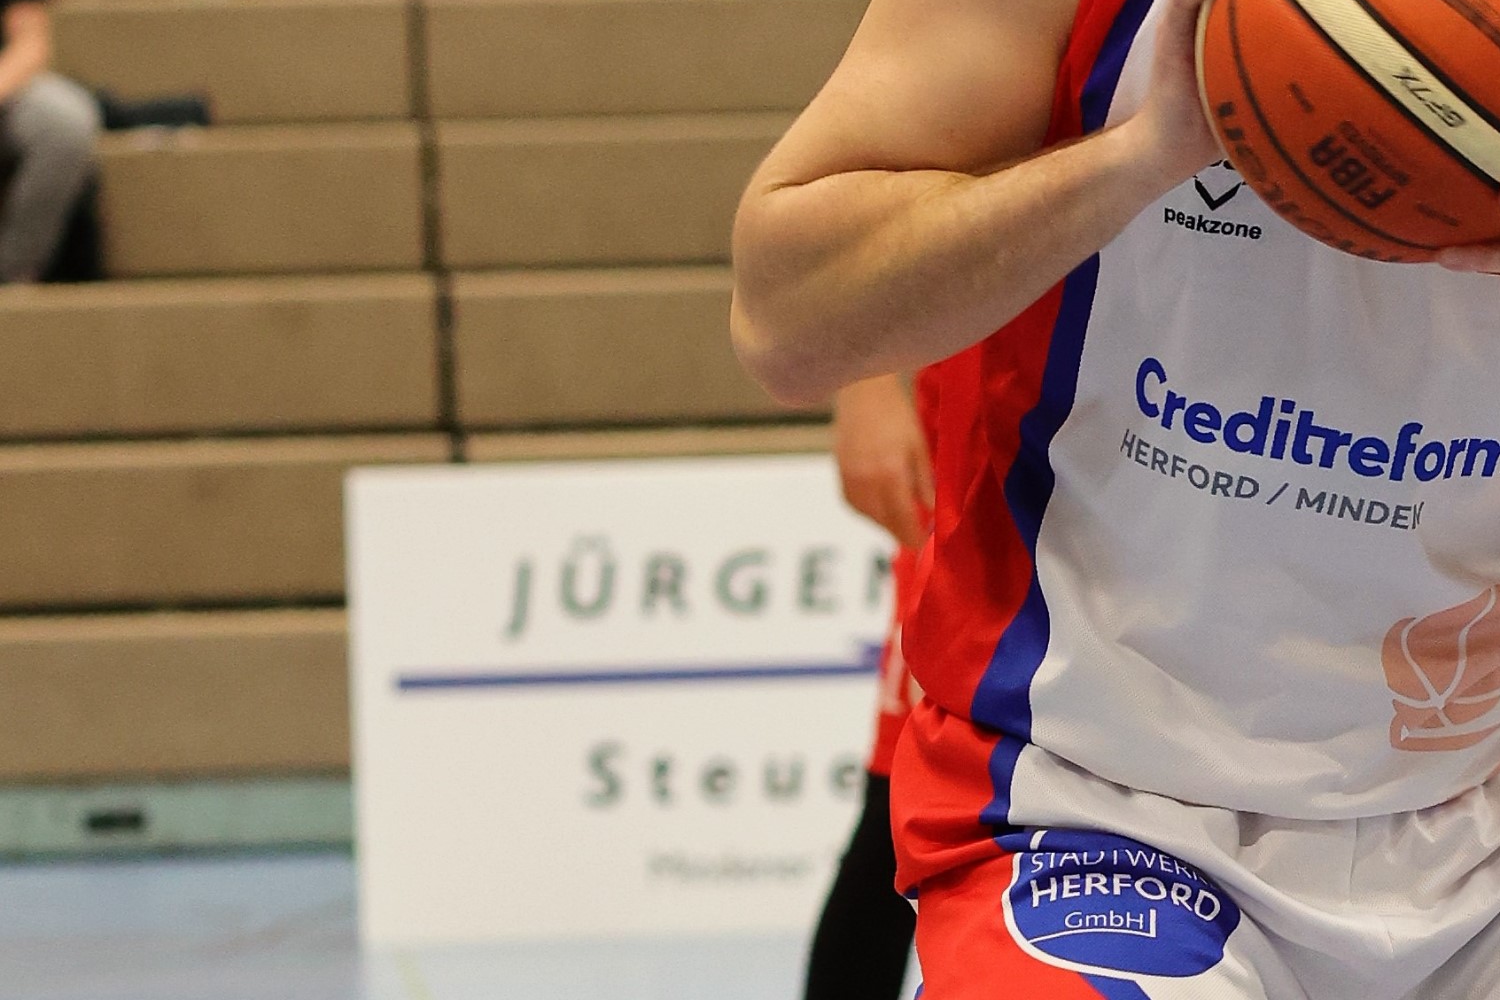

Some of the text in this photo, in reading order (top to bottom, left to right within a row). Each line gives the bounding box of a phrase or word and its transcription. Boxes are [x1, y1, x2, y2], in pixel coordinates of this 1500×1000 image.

[1309, 134, 1398, 210] FIBA
[1163, 206, 1263, 241] peakzone
[1119, 428, 1260, 499] HERFORD
[1295, 487, 1425, 531] MINDEN
[1030, 848, 1208, 886] STADTWER
[1029, 872, 1221, 923] HERFORD
[1064, 909, 1144, 930] GmbH
